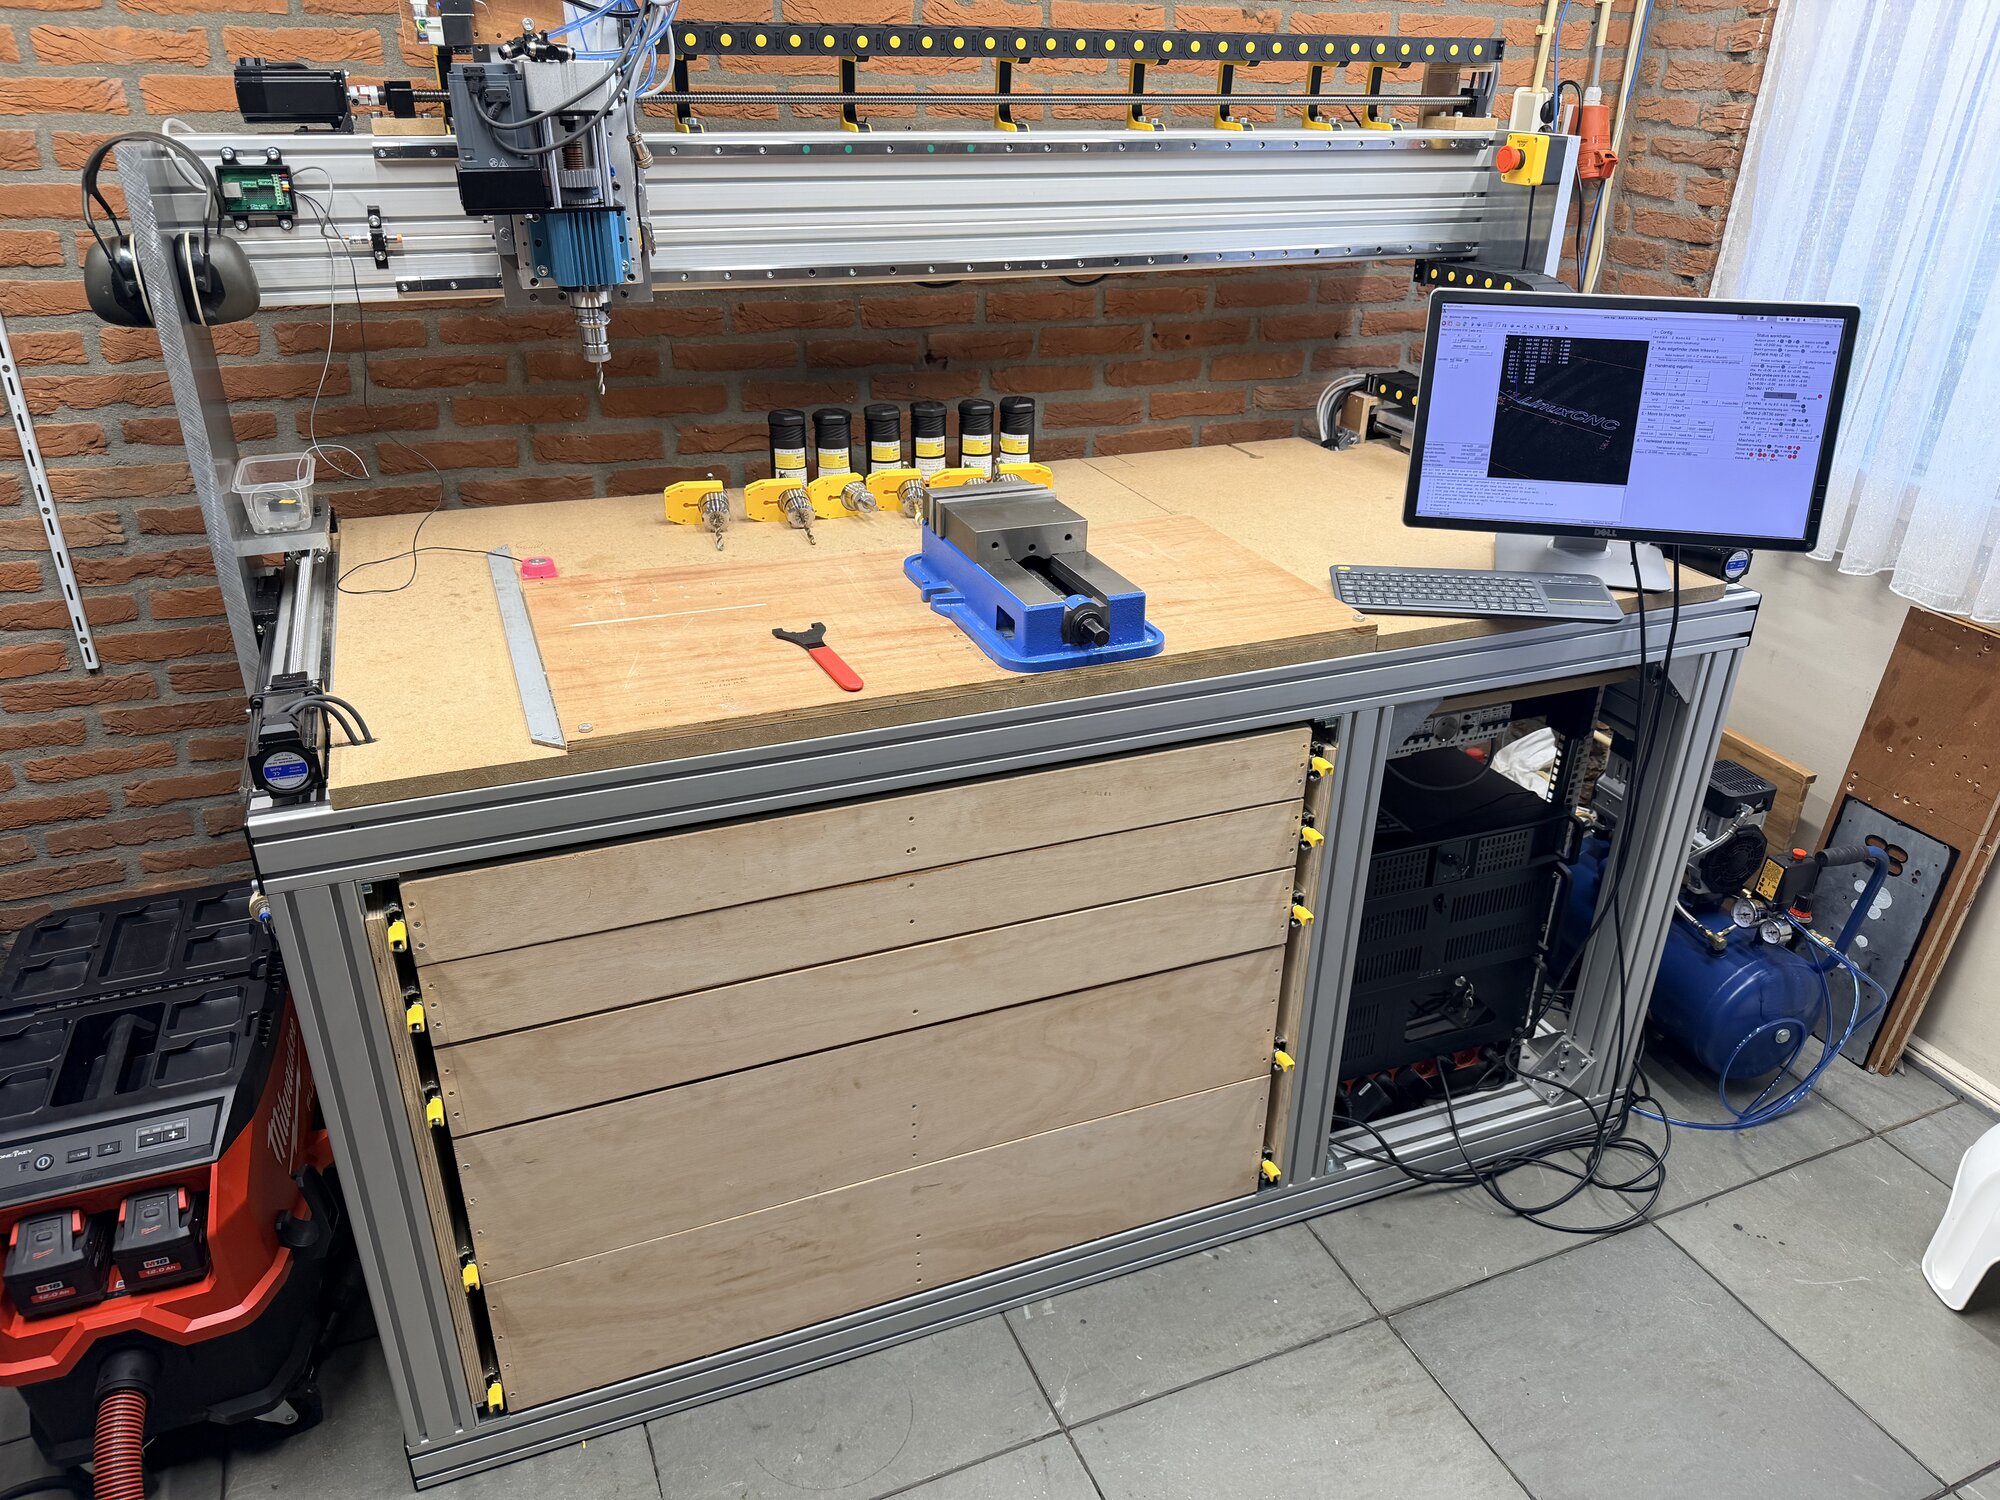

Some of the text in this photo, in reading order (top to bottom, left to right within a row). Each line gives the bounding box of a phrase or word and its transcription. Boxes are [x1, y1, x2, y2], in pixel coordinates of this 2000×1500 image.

[1516, 396, 1620, 431] LinuxCNC
[1594, 528, 1618, 537] DELL
[267, 1016, 297, 1165] Milwaukee
